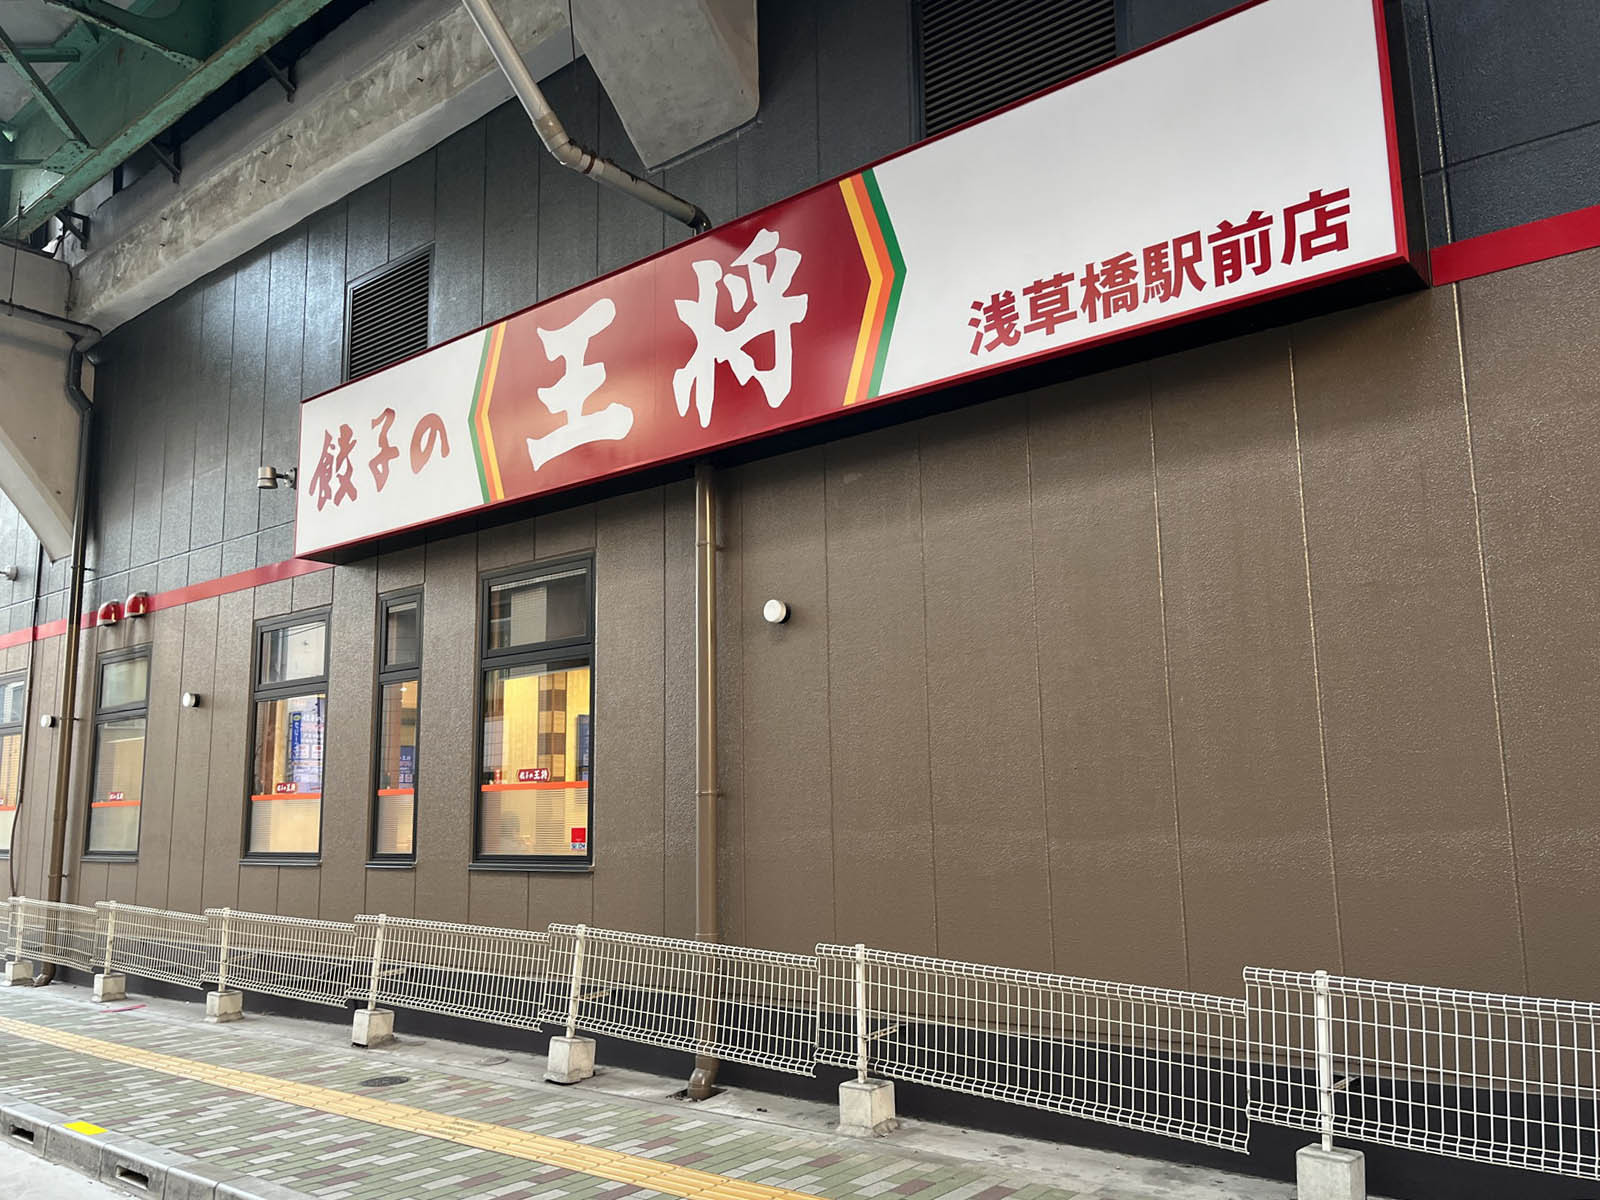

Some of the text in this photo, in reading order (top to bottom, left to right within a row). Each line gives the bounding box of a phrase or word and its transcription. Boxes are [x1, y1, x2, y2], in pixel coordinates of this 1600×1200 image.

[968, 187, 1351, 356] 浅草橋駅前店
